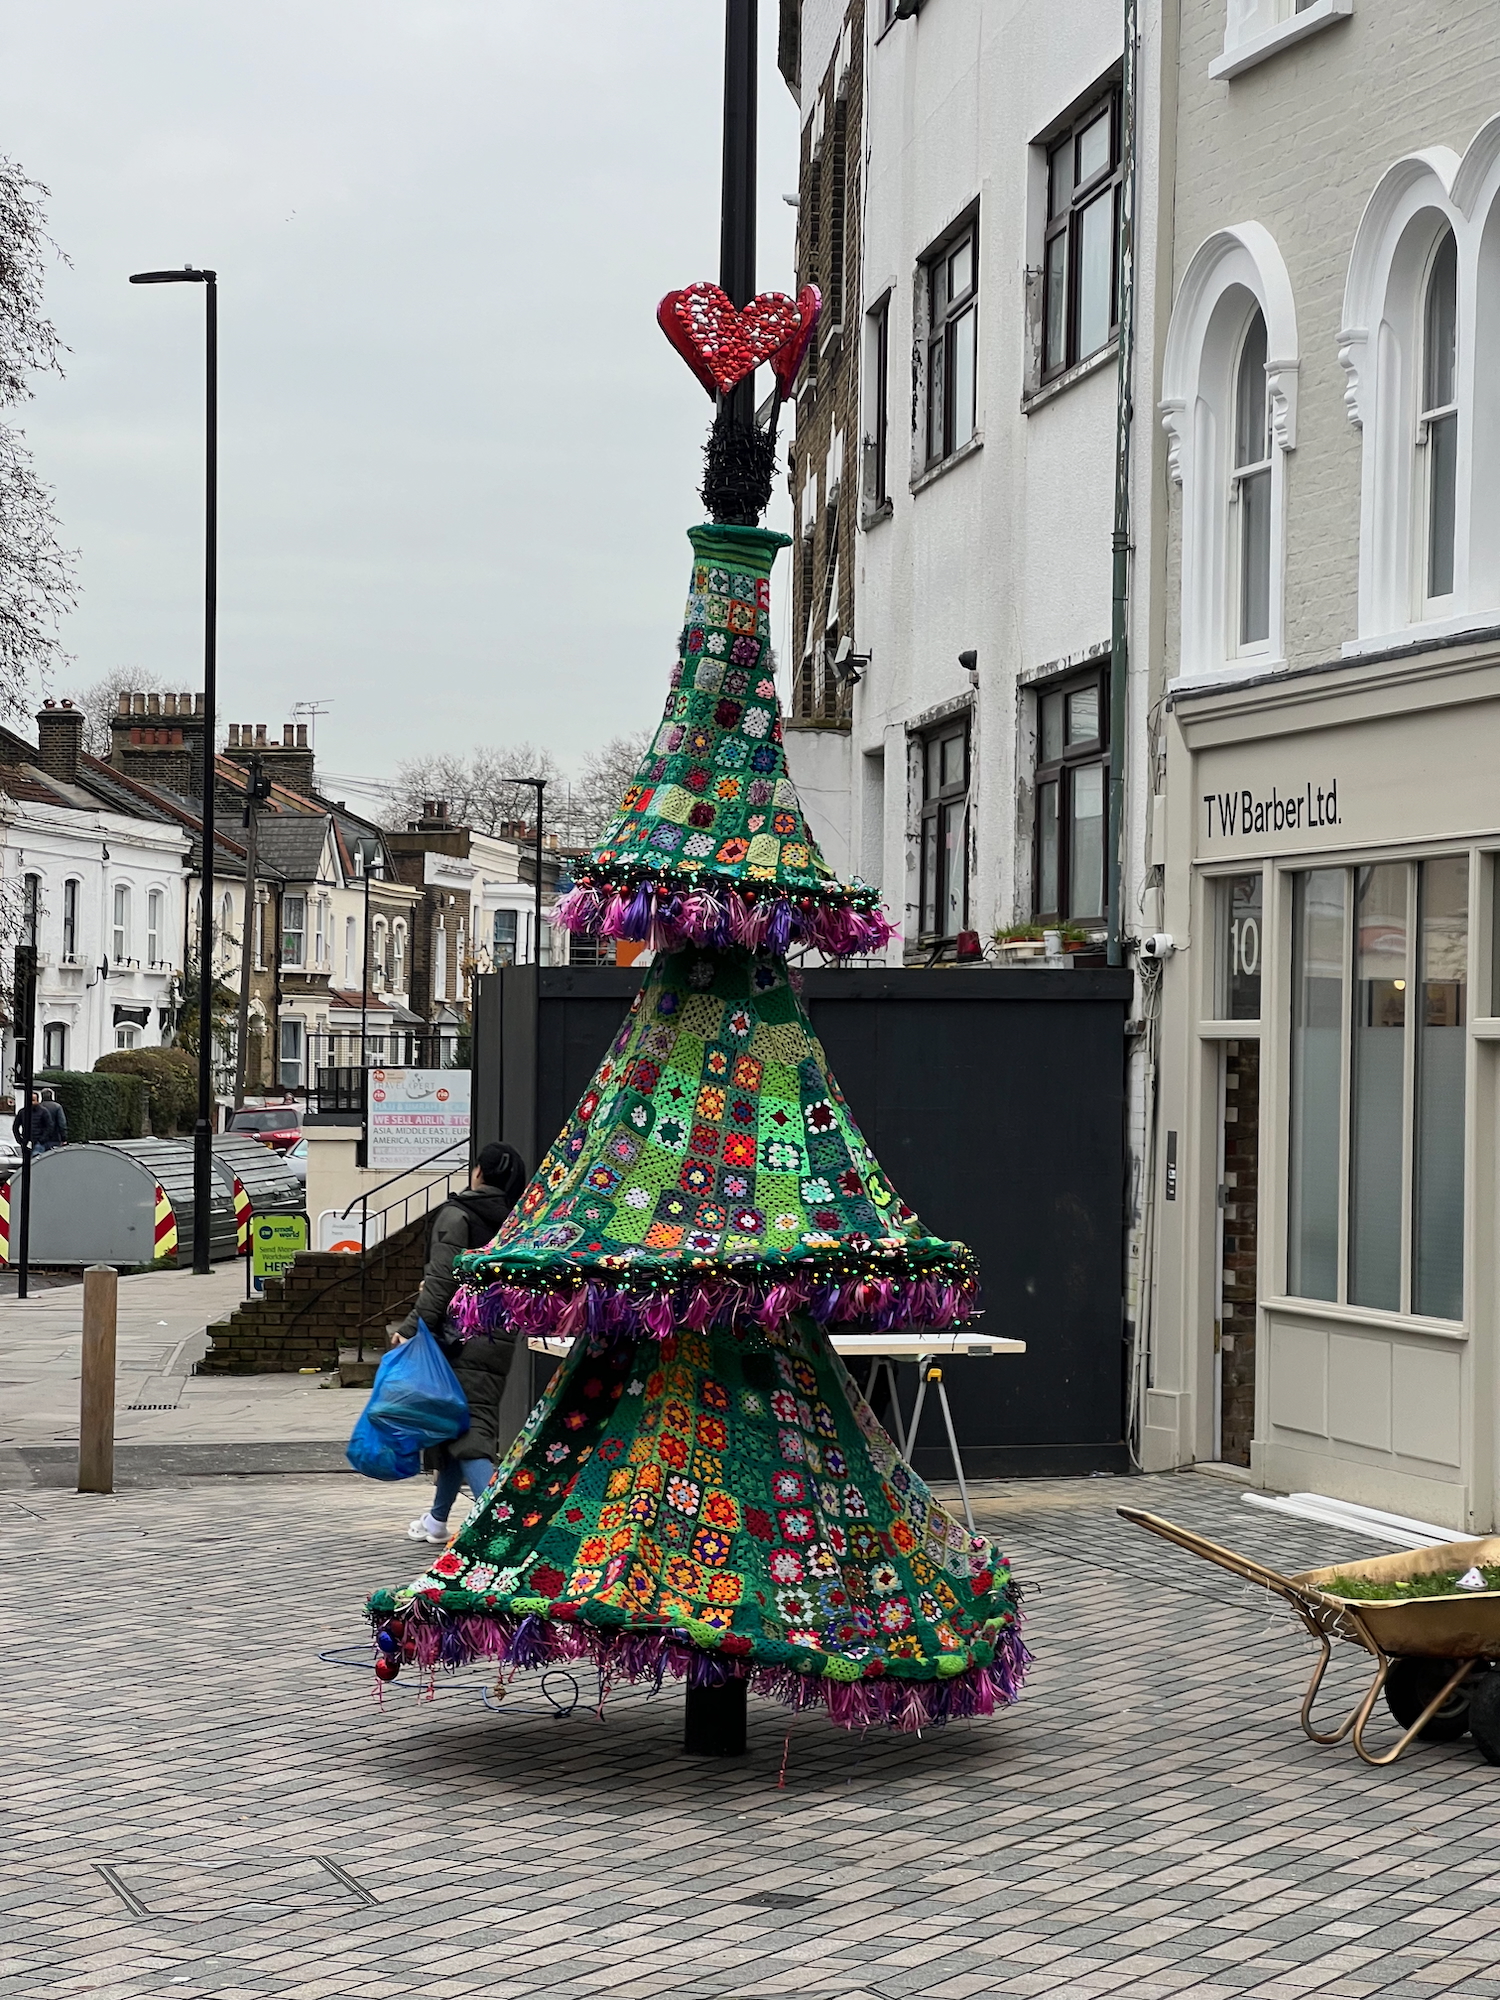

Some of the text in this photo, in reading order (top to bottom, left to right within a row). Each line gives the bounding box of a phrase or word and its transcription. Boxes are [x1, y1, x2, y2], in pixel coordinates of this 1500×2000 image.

[1241, 786, 1304, 835] Barber
[1307, 778, 1342, 828] Ltd.
[1230, 917, 1259, 976] 10
[374, 1115, 390, 1124] WE
[391, 1115, 414, 1125] SELL
[415, 1115, 453, 1125] AIRLINE
[373, 1127, 393, 1135] ASIA,
[395, 1127, 427, 1135] MIDDLE
[373, 1137, 411, 1145] AMERICA,
[414, 1137, 458, 1145] AUSTRALIA
